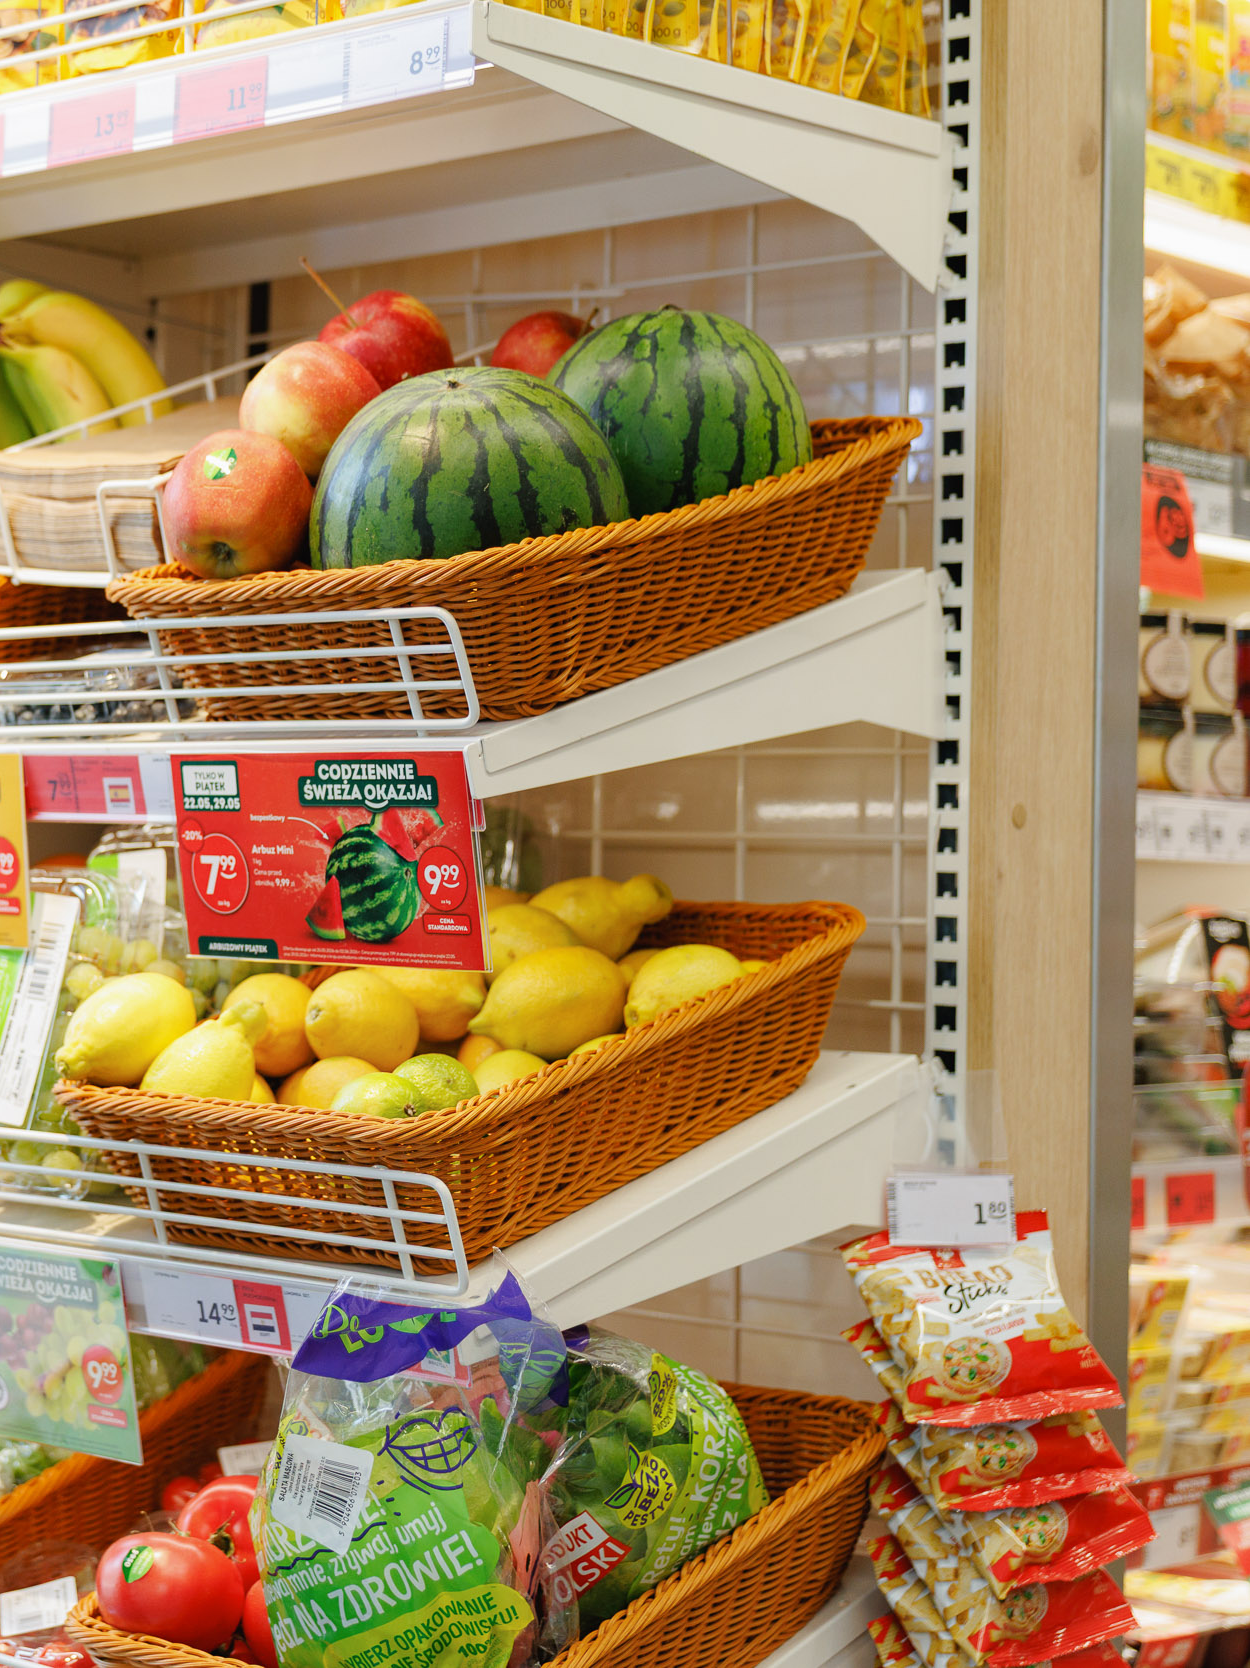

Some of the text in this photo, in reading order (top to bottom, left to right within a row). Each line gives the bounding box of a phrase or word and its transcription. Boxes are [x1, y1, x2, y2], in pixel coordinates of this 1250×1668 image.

[194, 772, 225, 780] TYLKO W
[318, 763, 415, 780] CODZIENNIE
[196, 782, 225, 794] PIĄTEK
[303, 779, 432, 801] ŚWIEŻA OKAZJA!
[252, 845, 294, 855] Arbuz Mini
[36, 1279, 93, 1303] OKAZJA!
[282, 1452, 295, 1479] MASŁOWA
[278, 1478, 290, 1501] SAŁATA
[638, 1472, 659, 1512] BEZ
[287, 1560, 333, 1593] mnie,
[395, 1501, 447, 1546] umyj
[639, 1516, 686, 1585] Rety!
[293, 1599, 337, 1640] NA
[327, 1529, 484, 1628] ZDROWIE!
[553, 1541, 625, 1604] OLSKI
[394, 1591, 498, 1652] OPAKOWANIE
[413, 1604, 520, 1668] ŚRODOWISKU!
